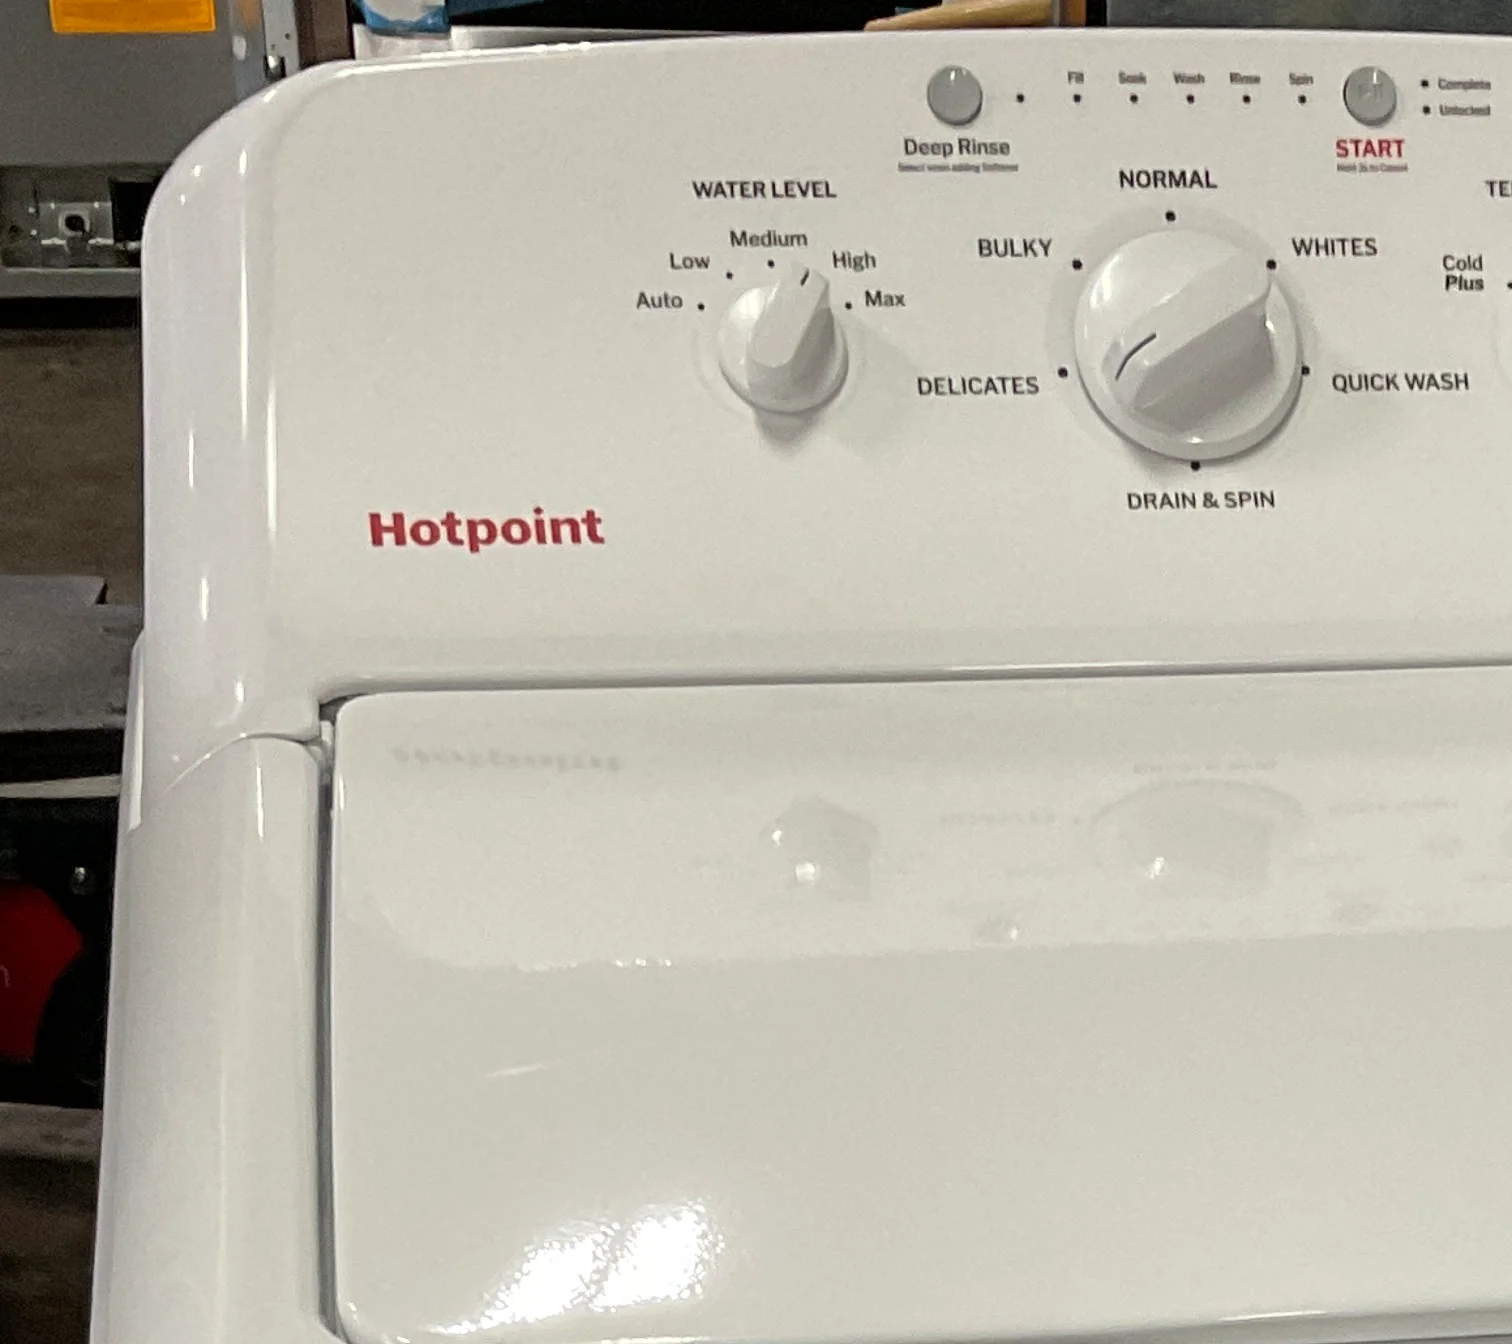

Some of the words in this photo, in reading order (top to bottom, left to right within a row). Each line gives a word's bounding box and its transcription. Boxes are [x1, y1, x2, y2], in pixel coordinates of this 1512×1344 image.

[904, 138, 953, 158] Deep
[958, 138, 1010, 155] Rinse
[1336, 139, 1404, 158] START
[1119, 170, 1217, 188] NORMAL
[692, 181, 766, 198] WATER
[771, 181, 837, 198] LEVEL
[730, 230, 808, 247] Medium
[1292, 238, 1377, 256] WHITES
[978, 239, 1052, 257] BULKY
[670, 253, 710, 270] Low
[832, 251, 876, 272] High
[1443, 254, 1483, 272] Cold
[1445, 275, 1484, 291] Plus
[636, 292, 682, 309] Auto
[865, 290, 905, 307] Max
[917, 377, 1039, 395] DELICATES
[1332, 374, 1399, 394] QUICK
[1405, 372, 1469, 391] WASH
[1127, 492, 1196, 509] DRAIN
[1203, 492, 1219, 509] &
[1224, 491, 1275, 508] SPIN
[368, 505, 606, 554] Hotpoint
